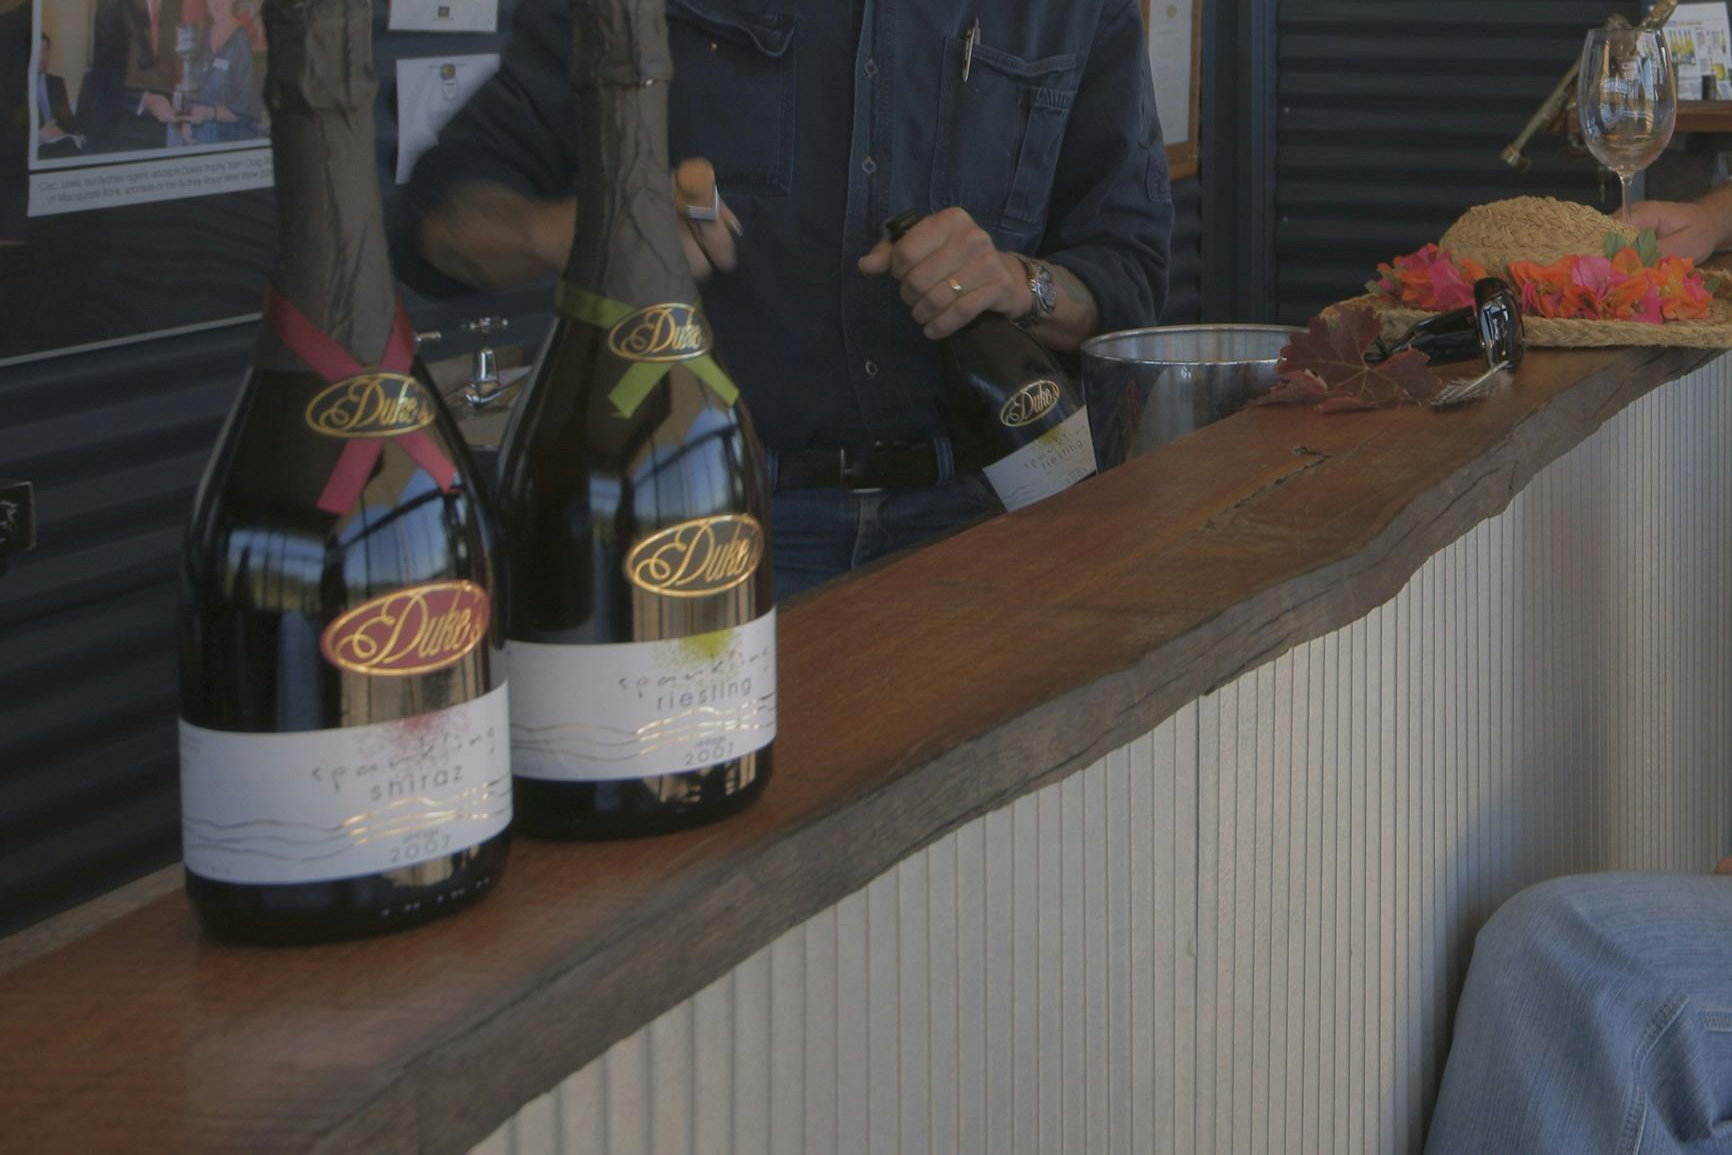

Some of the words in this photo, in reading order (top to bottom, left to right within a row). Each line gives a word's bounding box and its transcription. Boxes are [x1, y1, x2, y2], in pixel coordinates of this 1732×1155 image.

[336, 580, 483, 668] Duke's
[657, 677, 753, 711] riesling
[370, 765, 464, 801] shiraz
